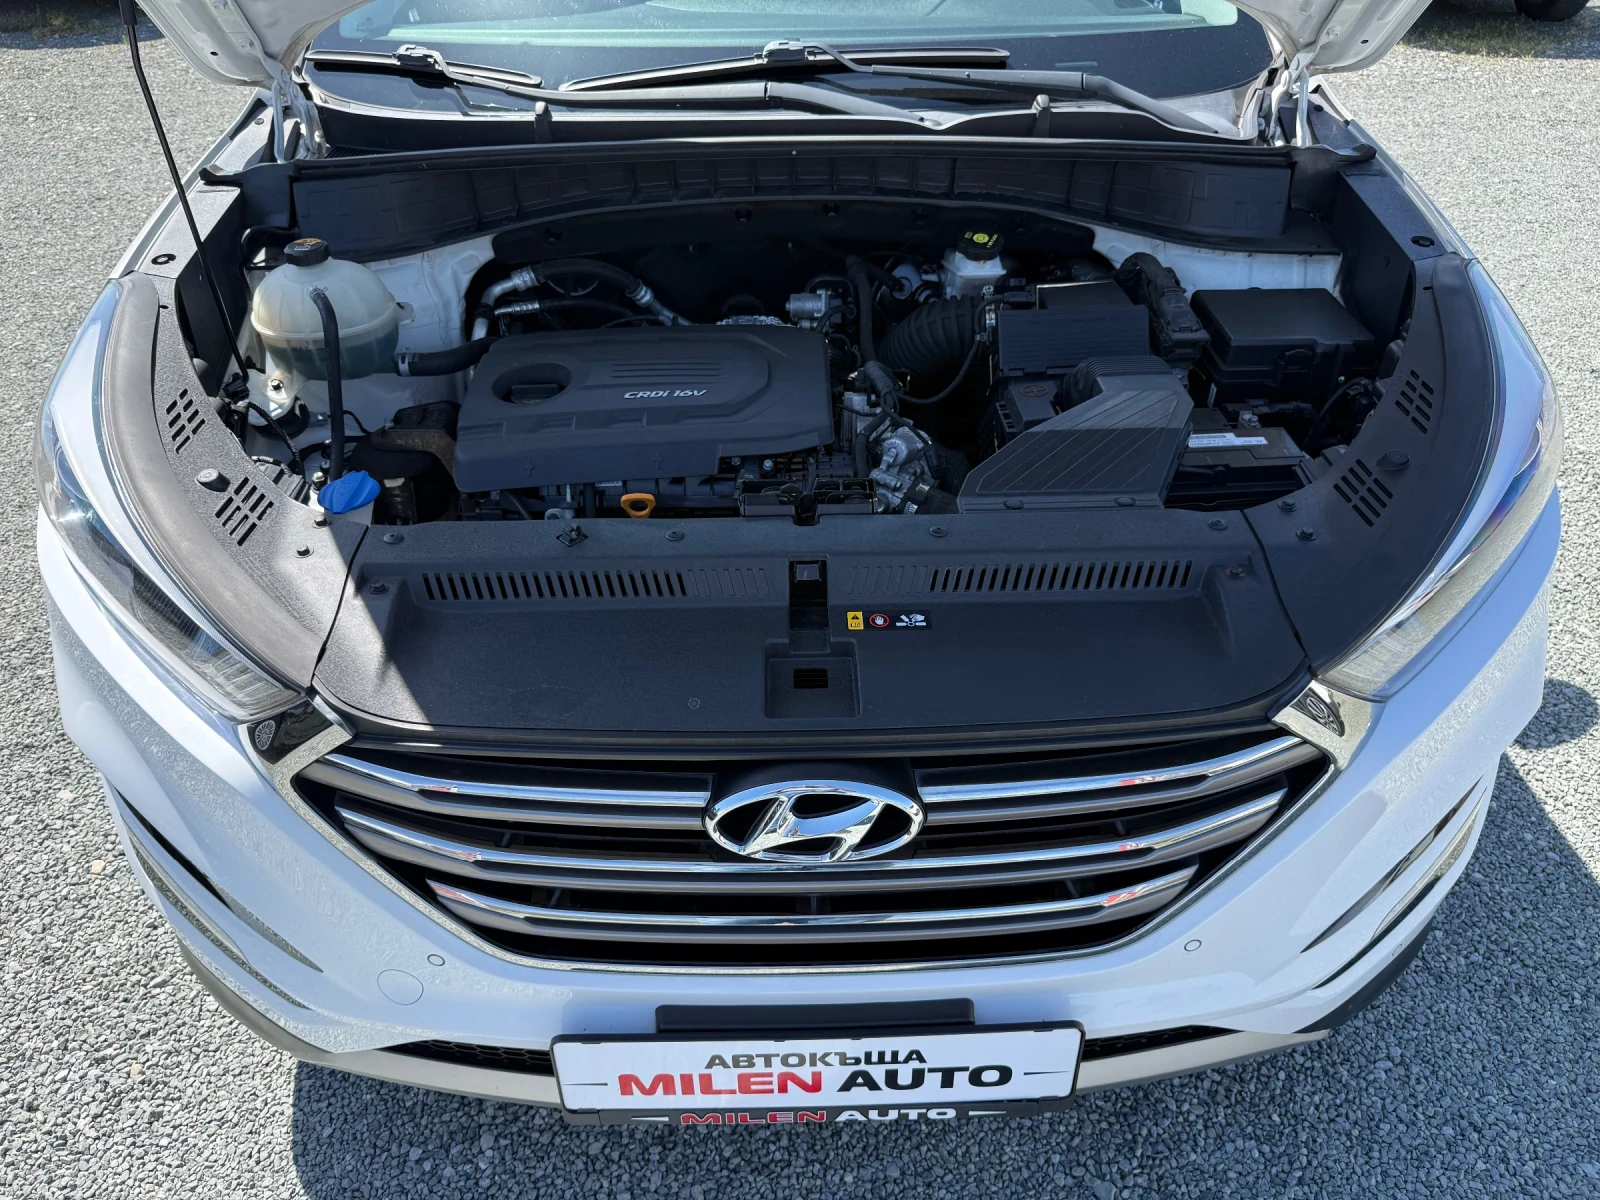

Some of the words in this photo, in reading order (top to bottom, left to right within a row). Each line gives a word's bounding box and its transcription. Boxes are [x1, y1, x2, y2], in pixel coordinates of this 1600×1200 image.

[623, 390, 671, 399] CRDi
[673, 389, 708, 397] 16V
[704, 1049, 928, 1070] АВТОКЪША
[617, 1070, 823, 1097] MILEN
[836, 1064, 1013, 1093] AUTO
[680, 1110, 827, 1125] MILEN
[834, 1107, 957, 1122] AUTO
